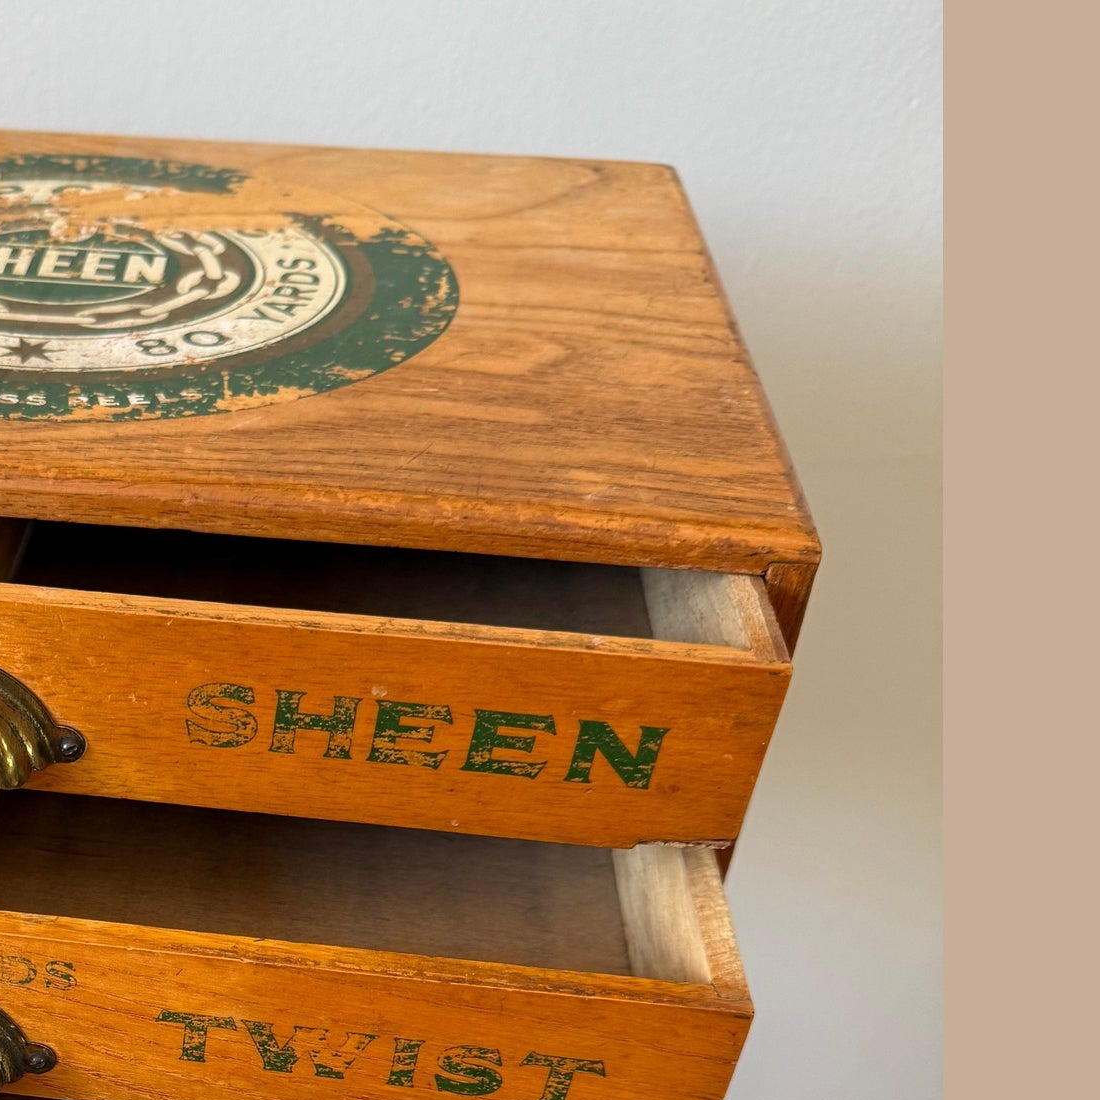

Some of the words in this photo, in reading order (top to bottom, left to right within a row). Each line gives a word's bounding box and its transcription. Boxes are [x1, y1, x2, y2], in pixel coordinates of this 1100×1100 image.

[135, 331, 225, 357] 80
[235, 257, 321, 324] YARDS
[184, 681, 672, 791] SHEEN
